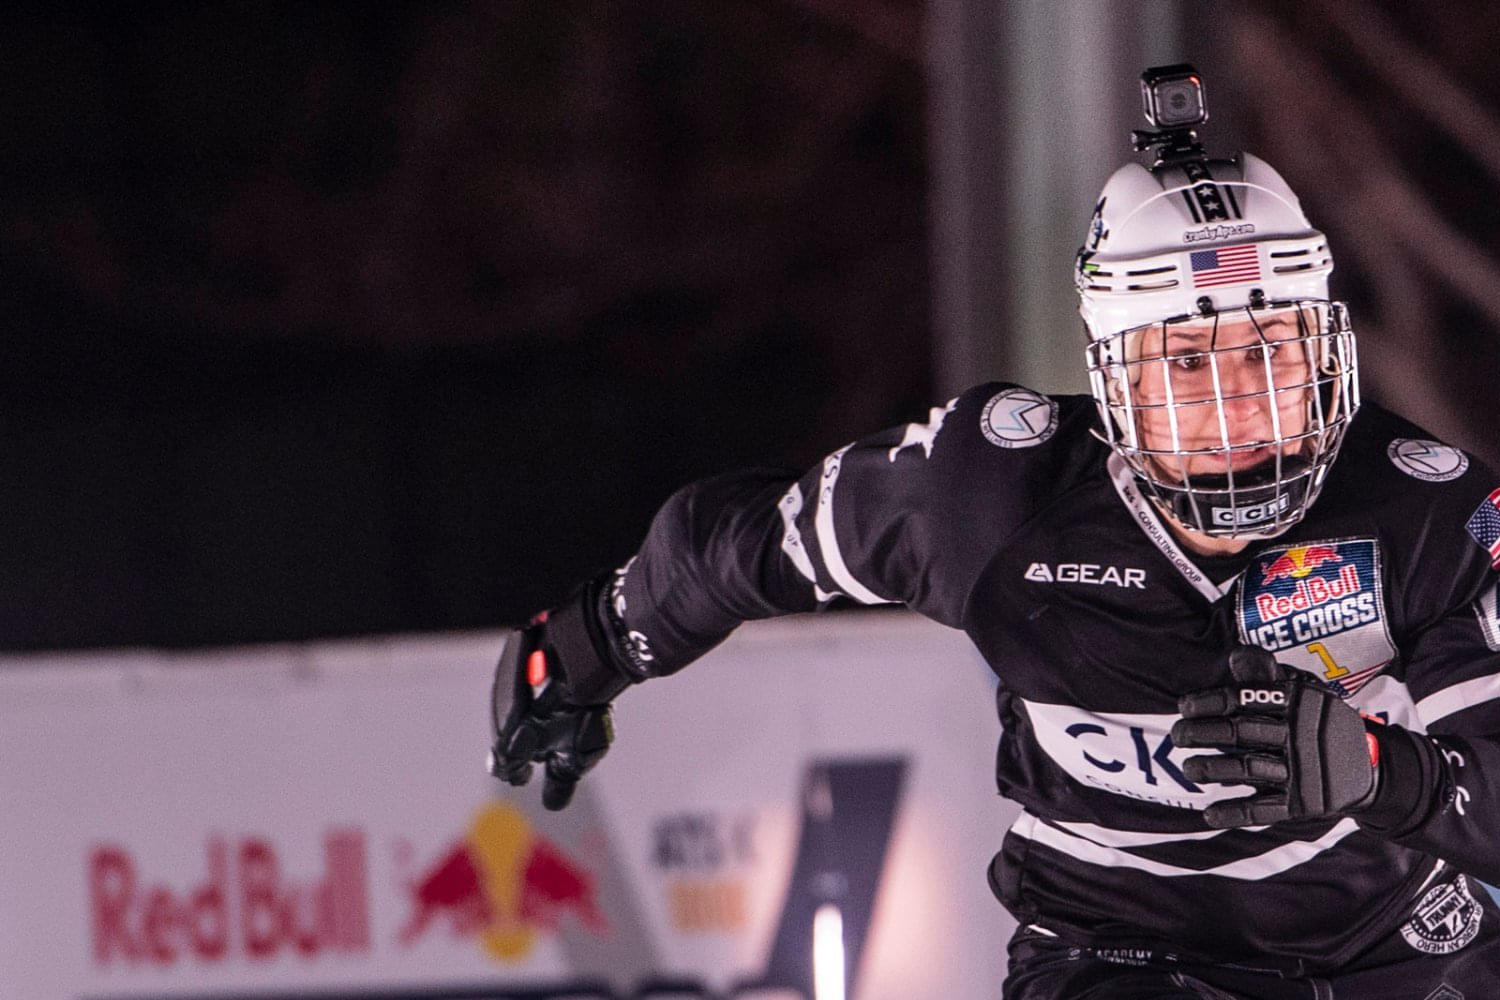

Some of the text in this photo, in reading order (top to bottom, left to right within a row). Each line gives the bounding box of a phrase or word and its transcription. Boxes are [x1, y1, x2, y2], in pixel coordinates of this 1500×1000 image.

[1219, 496, 1289, 519] CCM
[1138, 511, 1177, 559] CONSULTING
[1175, 558, 1202, 583] GROUP
[1249, 592, 1376, 651] ICE CROSS
[1256, 563, 1362, 623] Red Bull
[1307, 642, 1350, 680] 1
[90, 823, 371, 971] Red Bull
[1416, 939, 1446, 953] HERO
